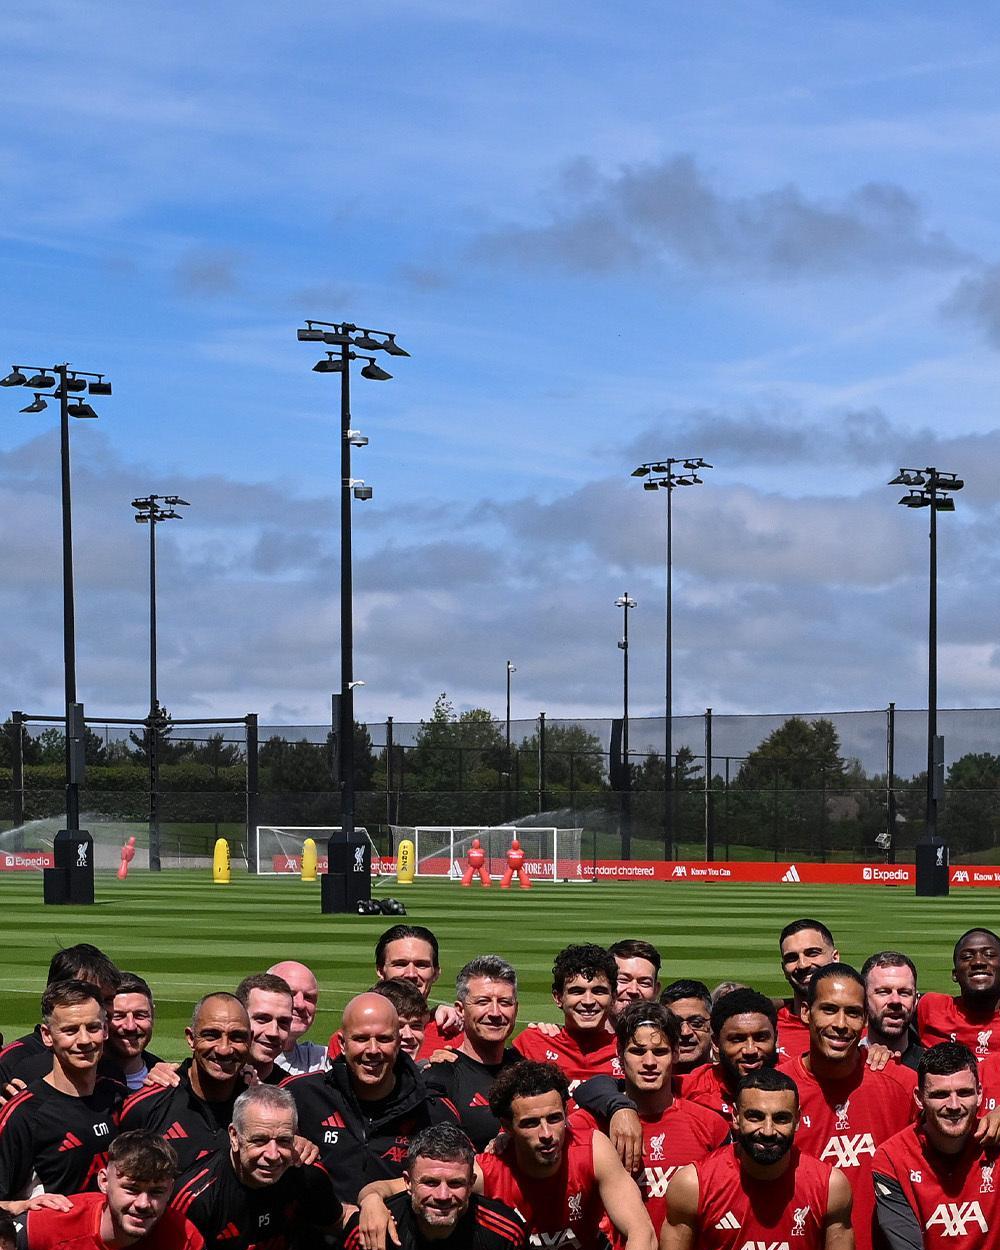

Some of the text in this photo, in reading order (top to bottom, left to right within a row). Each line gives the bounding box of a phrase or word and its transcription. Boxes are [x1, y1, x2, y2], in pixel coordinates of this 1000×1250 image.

[16, 857, 50, 867] Expedia
[583, 866, 654, 876] standard chartered
[672, 866, 687, 877] AXA
[691, 867, 731, 876] Know You Can
[873, 869, 909, 881] Expedia
[952, 870, 970, 882] AXA
[973, 872, 993, 881] Know
[985, 1098, 996, 1110] 18
[803, 1115, 811, 1128] 4
[93, 1122, 110, 1137] CM
[324, 1130, 339, 1144] AS
[820, 1133, 877, 1168] AXA
[910, 1169, 922, 1183] 26
[925, 1200, 989, 1237] AXA
